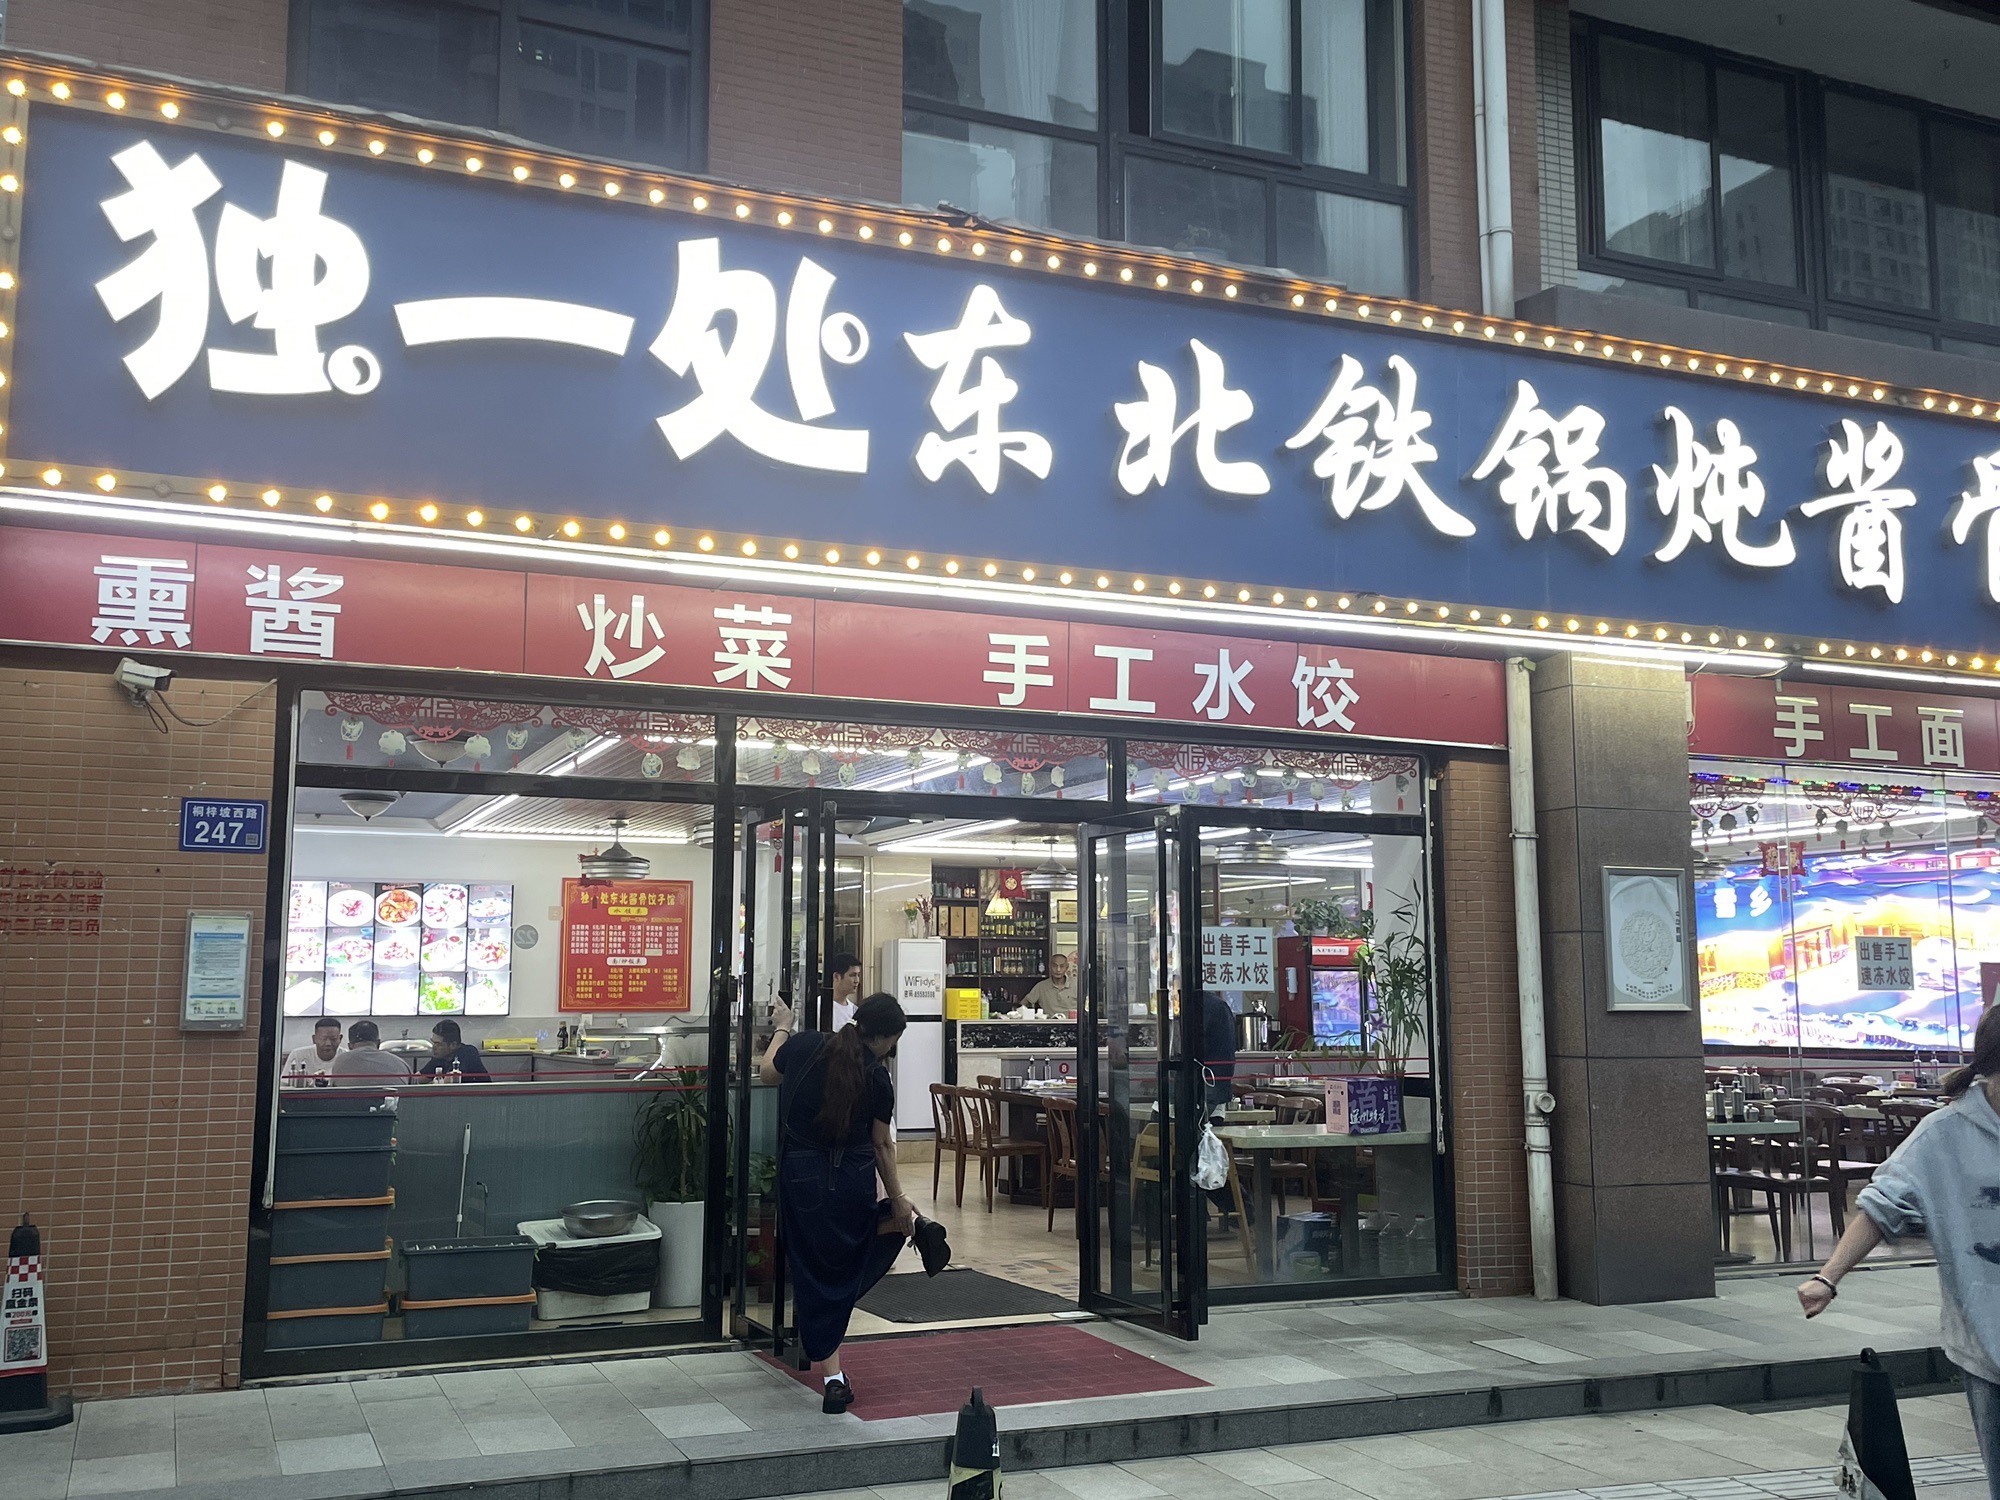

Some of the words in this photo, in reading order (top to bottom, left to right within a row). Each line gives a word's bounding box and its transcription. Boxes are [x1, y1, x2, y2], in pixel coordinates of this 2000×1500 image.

[91, 554, 345, 658] 熏酱
[577, 594, 793, 690] 炒菜
[986, 633, 1360, 732] 手工水饺
[1773, 695, 1965, 768] 手工面
[192, 805, 258, 819] 桐梓坡西路
[194, 821, 244, 844] 247
[1202, 933, 1268, 957] 出售手工
[1860, 942, 1909, 961] 出售手工
[1202, 961, 1269, 985] 速冻水饺
[1861, 966, 1910, 986] 速冻水饺
[1061, 1064, 1067, 1073] 8
[12, 1287, 33, 1298] 扫码
